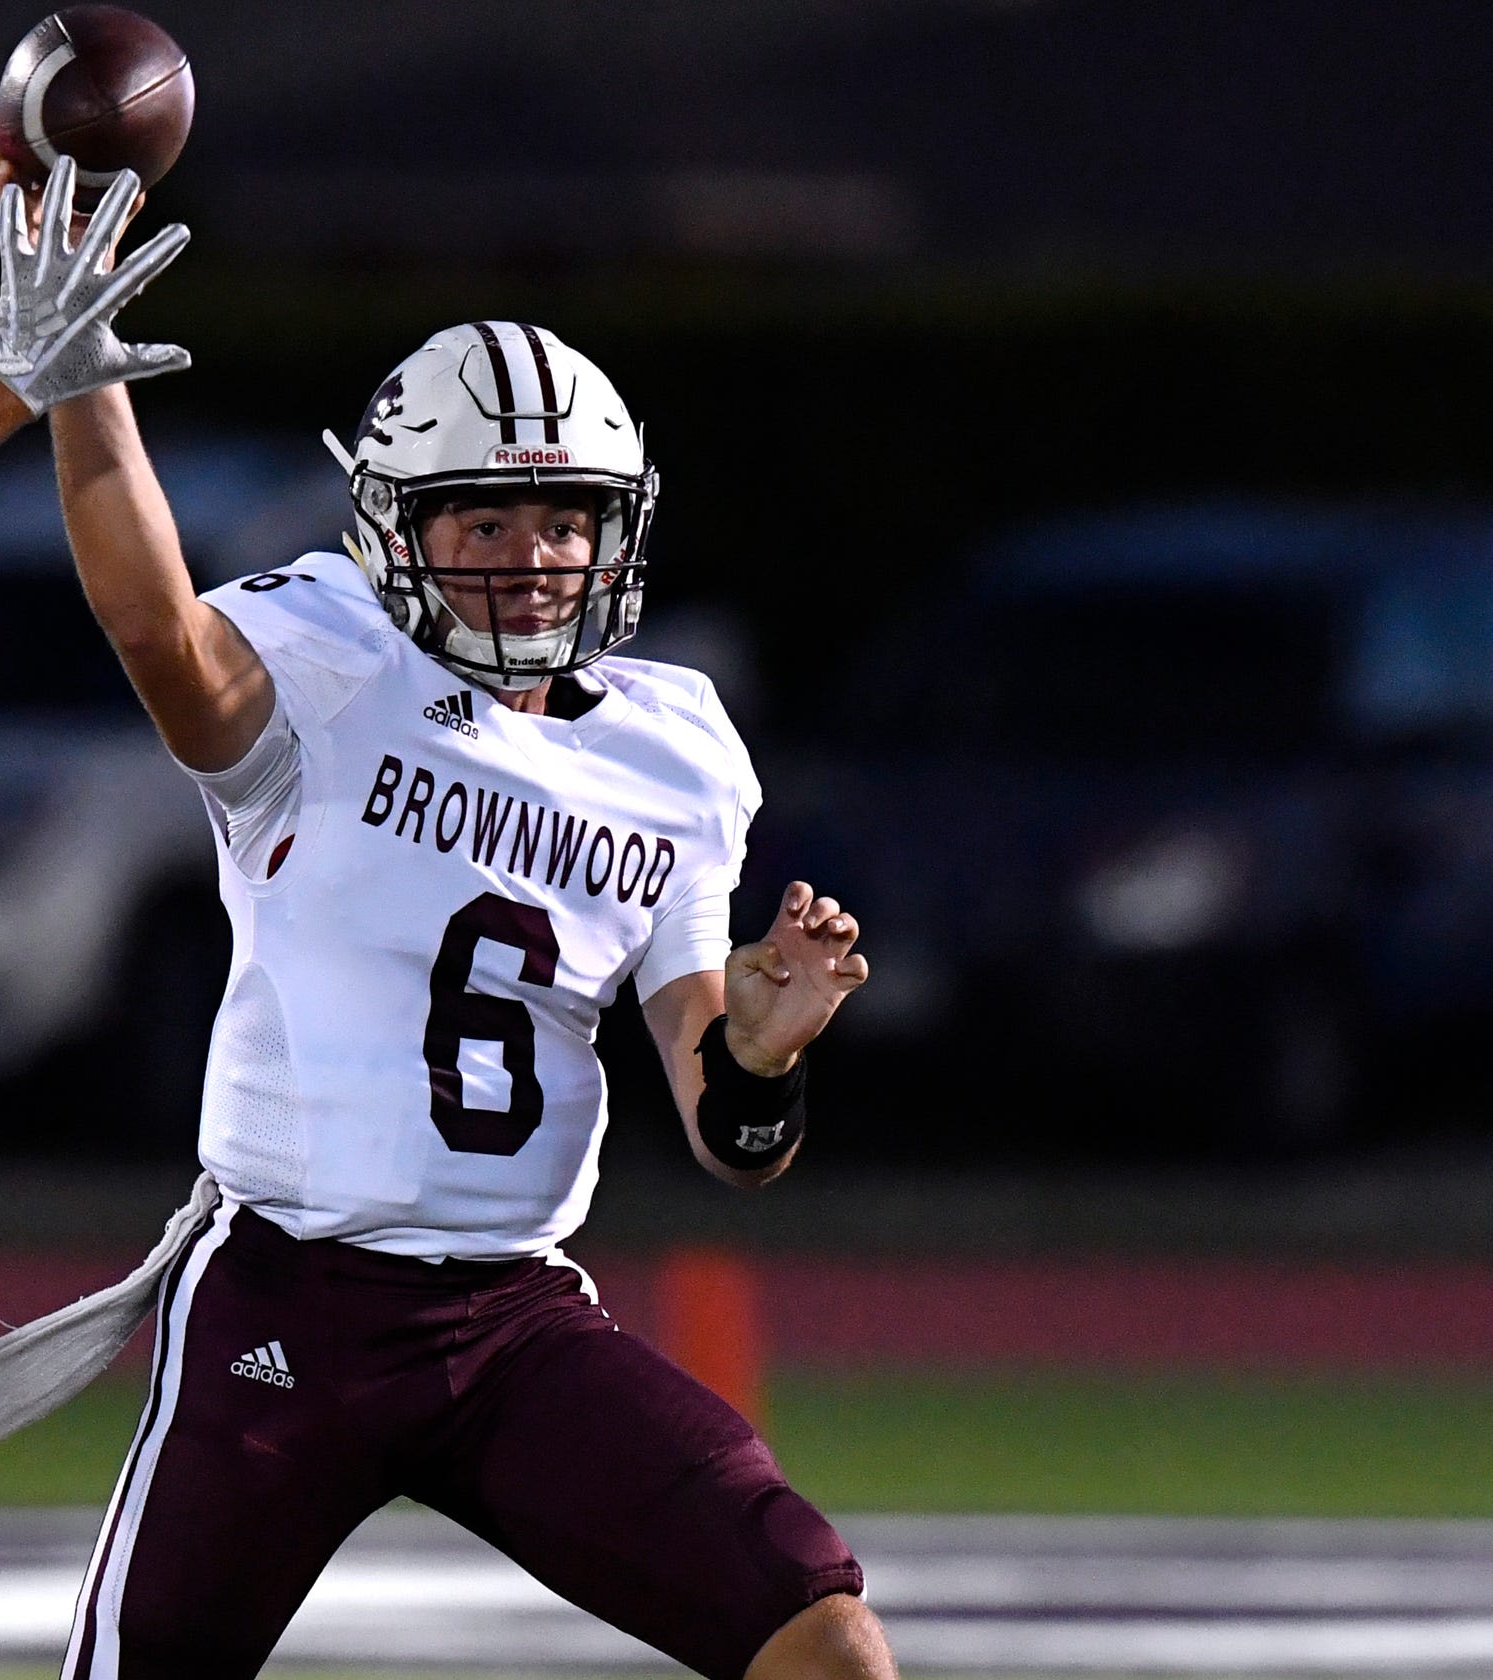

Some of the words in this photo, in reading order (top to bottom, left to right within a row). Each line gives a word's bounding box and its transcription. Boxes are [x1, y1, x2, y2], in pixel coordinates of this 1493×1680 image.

[495, 449, 570, 464] Riddell
[509, 656, 548, 666] Riddell
[423, 706, 479, 740] adidas
[361, 754, 675, 908] BROWNWOOD
[423, 891, 560, 1157] 6
[230, 1361, 295, 1389] adidas
